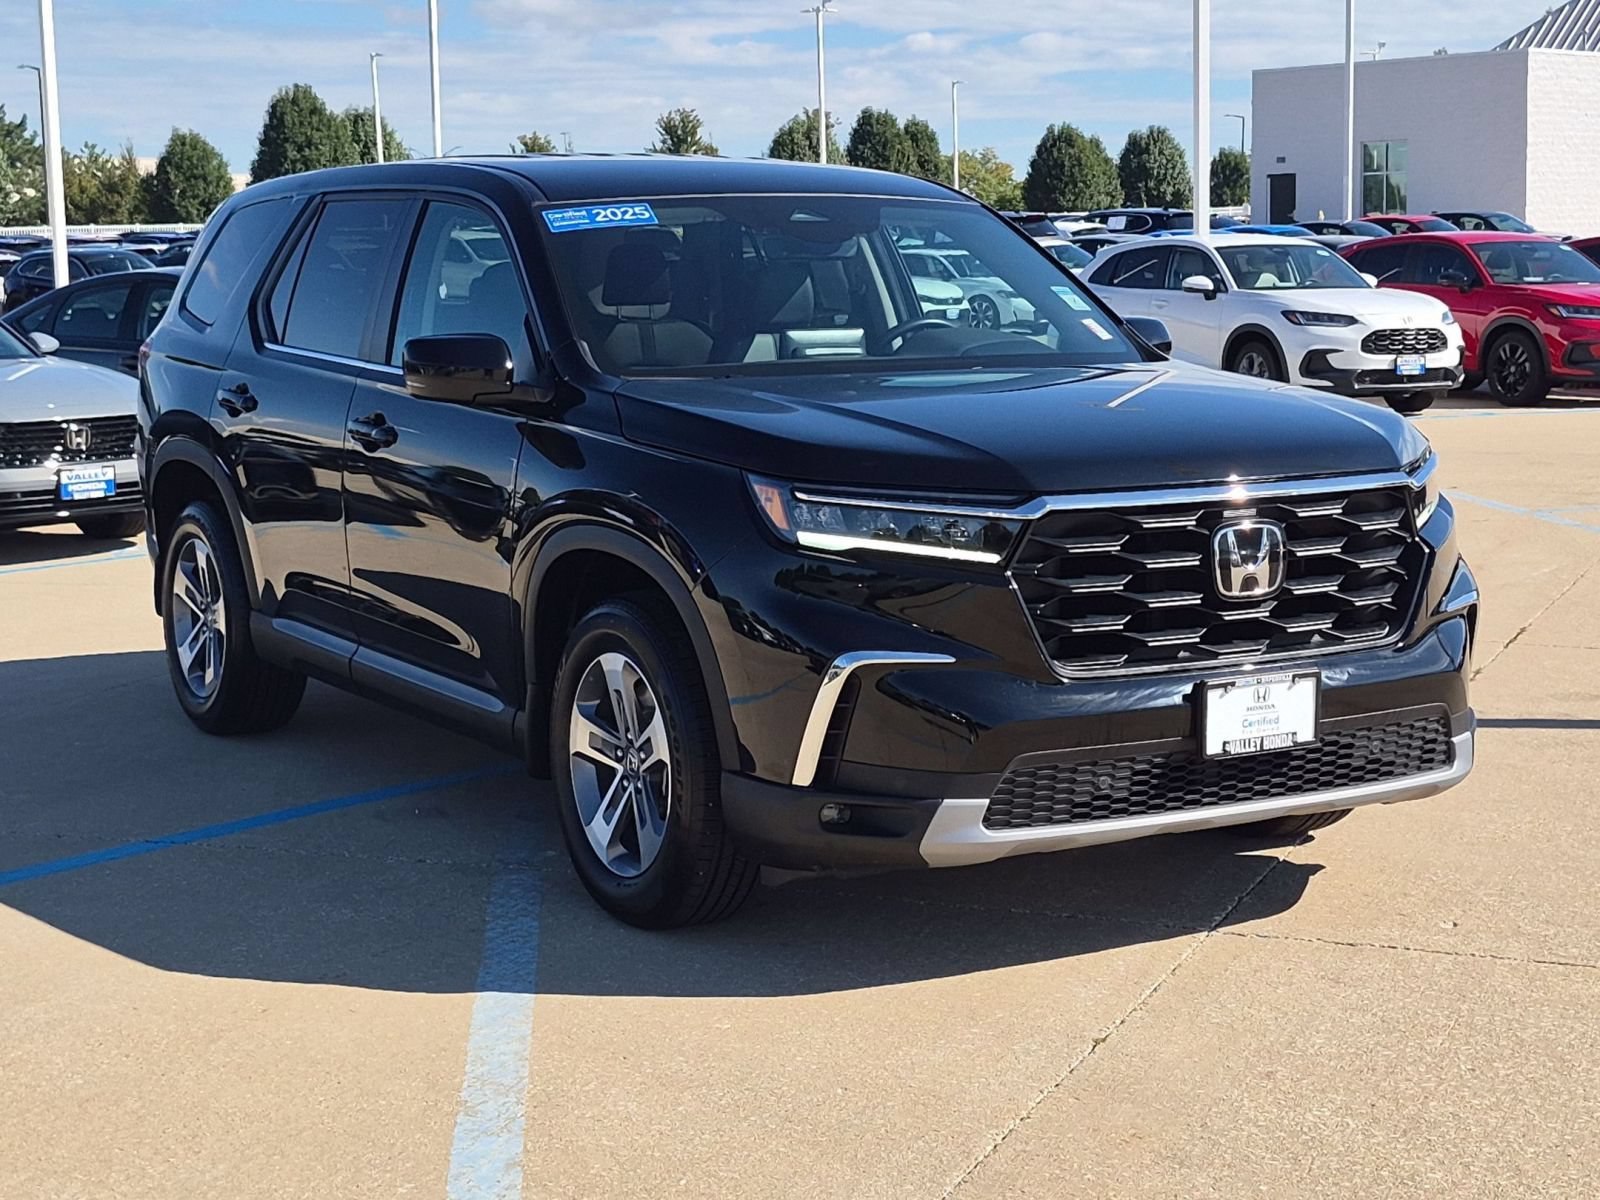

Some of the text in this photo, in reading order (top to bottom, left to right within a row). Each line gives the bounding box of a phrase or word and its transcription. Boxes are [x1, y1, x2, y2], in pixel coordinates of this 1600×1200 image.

[592, 207, 650, 221] 2025
[67, 471, 108, 480] VALLEY
[1246, 704, 1276, 712] HONDA
[1242, 715, 1279, 728] Certified
[1230, 734, 1293, 755] VALLEY HONDA
